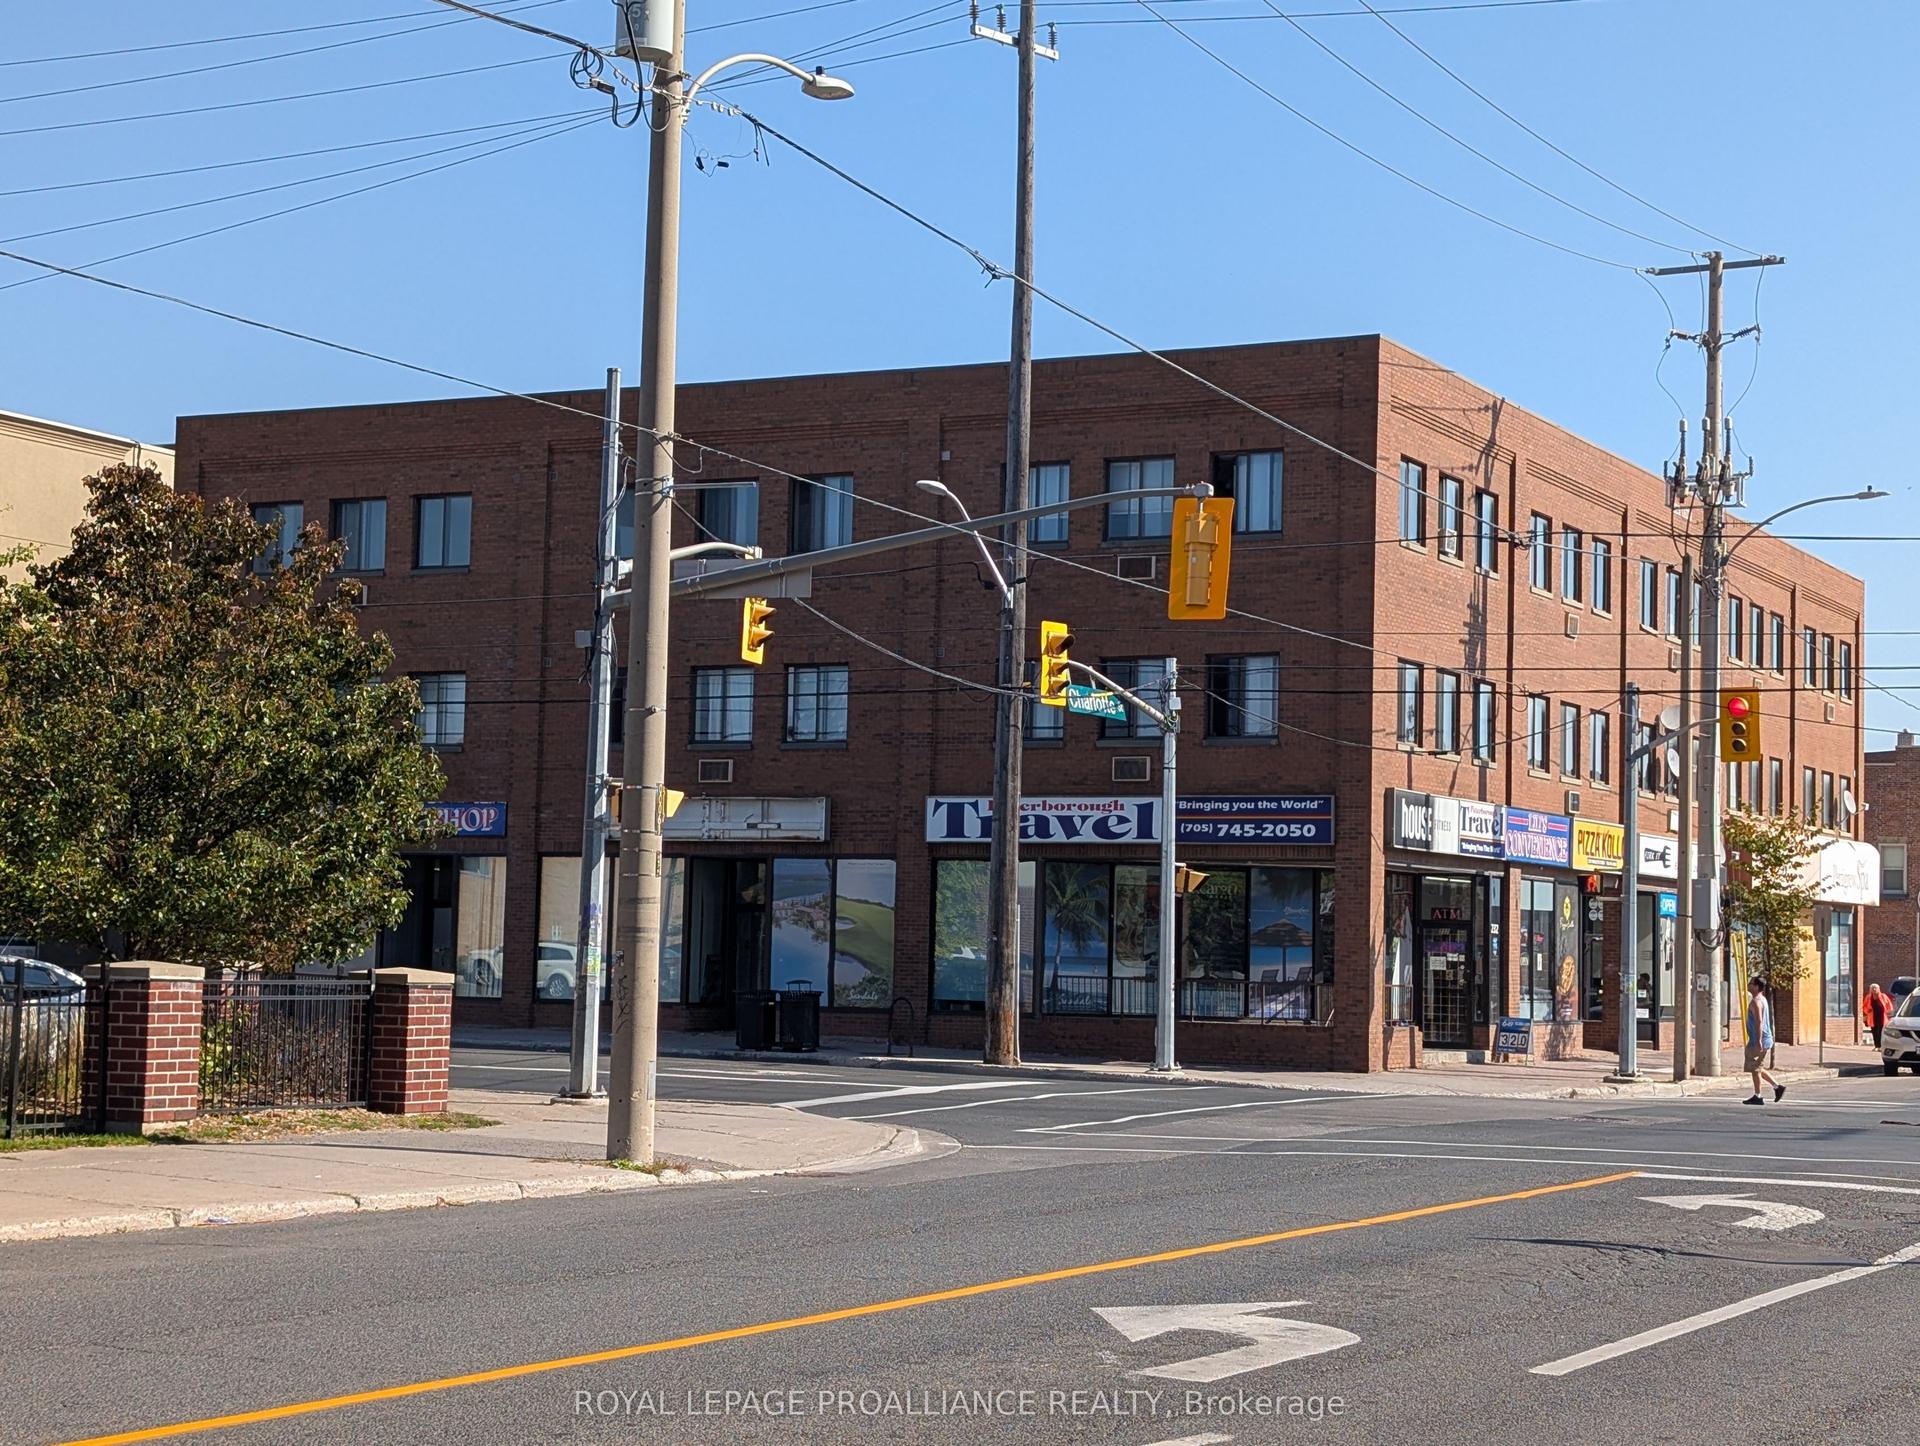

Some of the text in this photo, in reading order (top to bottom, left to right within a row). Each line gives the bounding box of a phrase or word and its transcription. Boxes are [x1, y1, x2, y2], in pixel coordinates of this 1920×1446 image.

[1069, 688, 1116, 715] Charlotte
[987, 799, 1125, 814] erborough
[1232, 802, 1255, 811] you
[1257, 800, 1278, 809] the
[1181, 823, 1316, 837] (705) 745-2050
[1401, 798, 1432, 841] house
[1461, 806, 1504, 836] Travel
[1506, 830, 1568, 863] CONVENIENCE
[1432, 909, 1461, 919] ATM
